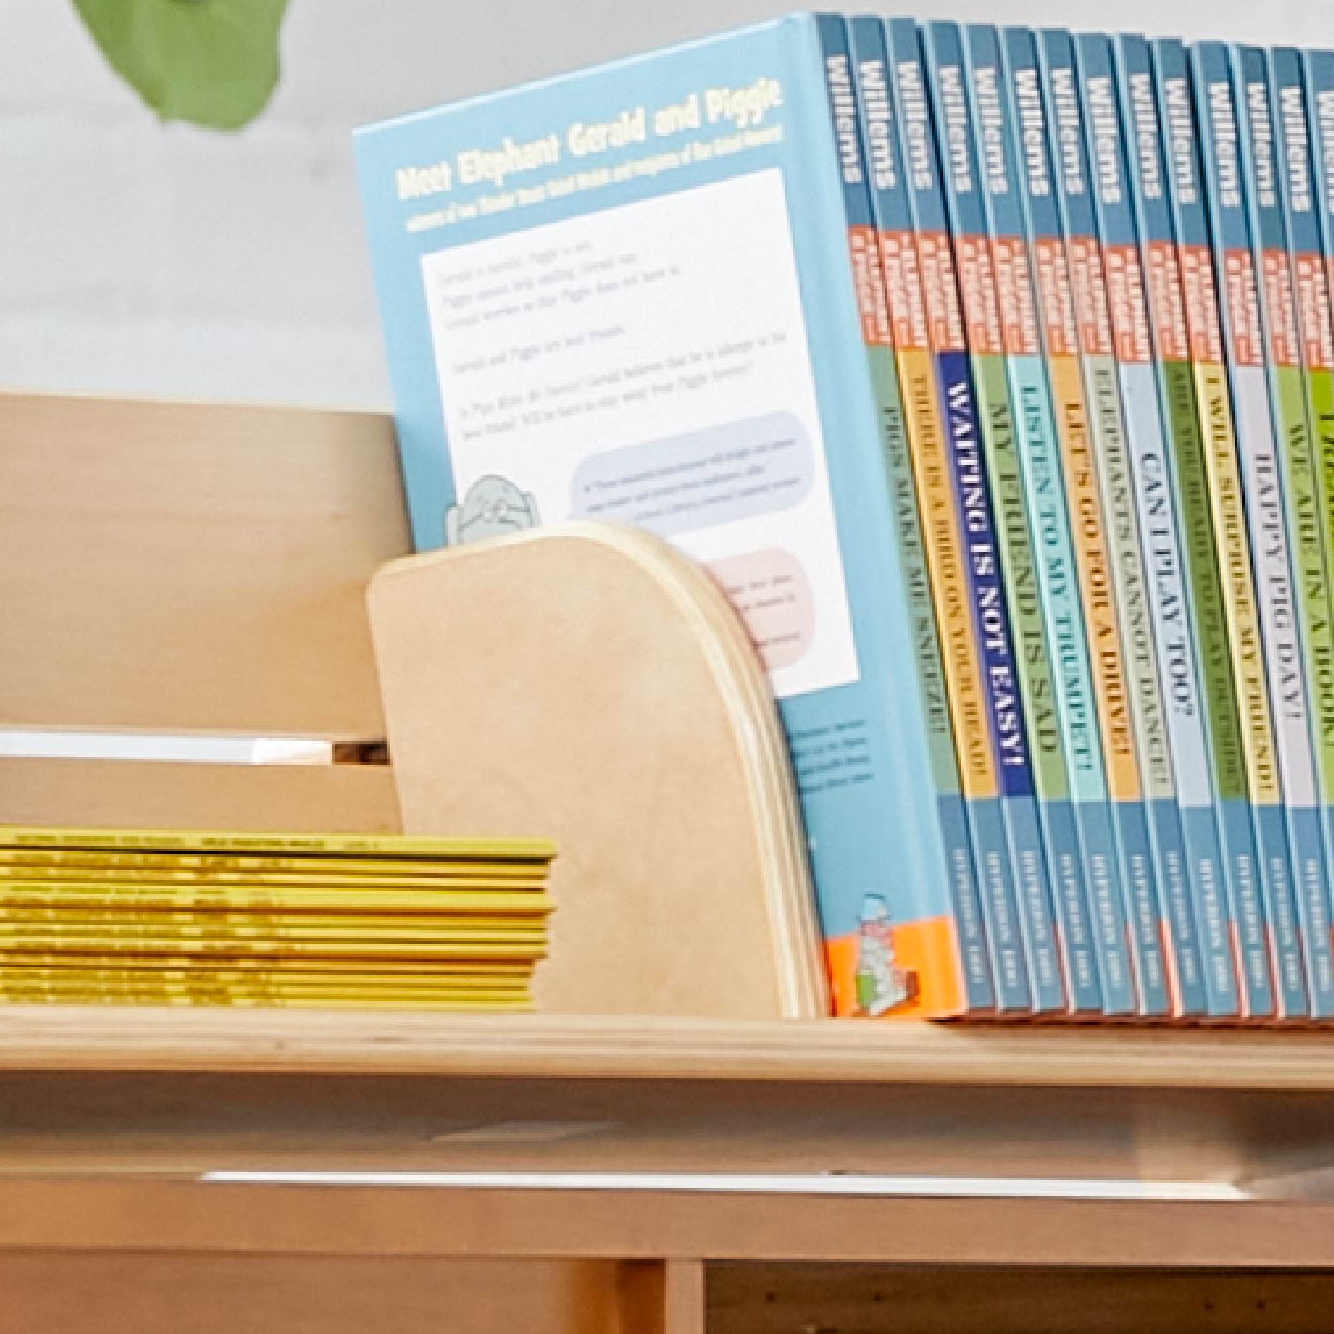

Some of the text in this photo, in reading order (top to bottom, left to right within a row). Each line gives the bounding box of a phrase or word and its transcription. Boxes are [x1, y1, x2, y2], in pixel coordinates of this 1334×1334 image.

[653, 94, 701, 138] and
[1064, 402, 1093, 488] LET'S
[1286, 424, 1310, 475] WE
[1077, 497, 1100, 538] GO
[1139, 452, 1167, 516] CAN
[1295, 493, 1319, 555] ARE
[946, 380, 1024, 765] WAITING IS NOT EASY!
[988, 402, 1057, 753] MY FRIEND IS SAD
[1021, 384, 1092, 770] LISTEN TO MY TRUMPET!
[1084, 548, 1110, 610] FOR
[1152, 551, 1181, 625] PLAY
[1252, 453, 1302, 719] HAPPY PIG DAY!
[1304, 569, 1324, 600] IN
[1098, 651, 1129, 754] DRIVE!
[1163, 636, 1193, 716] TOO?
